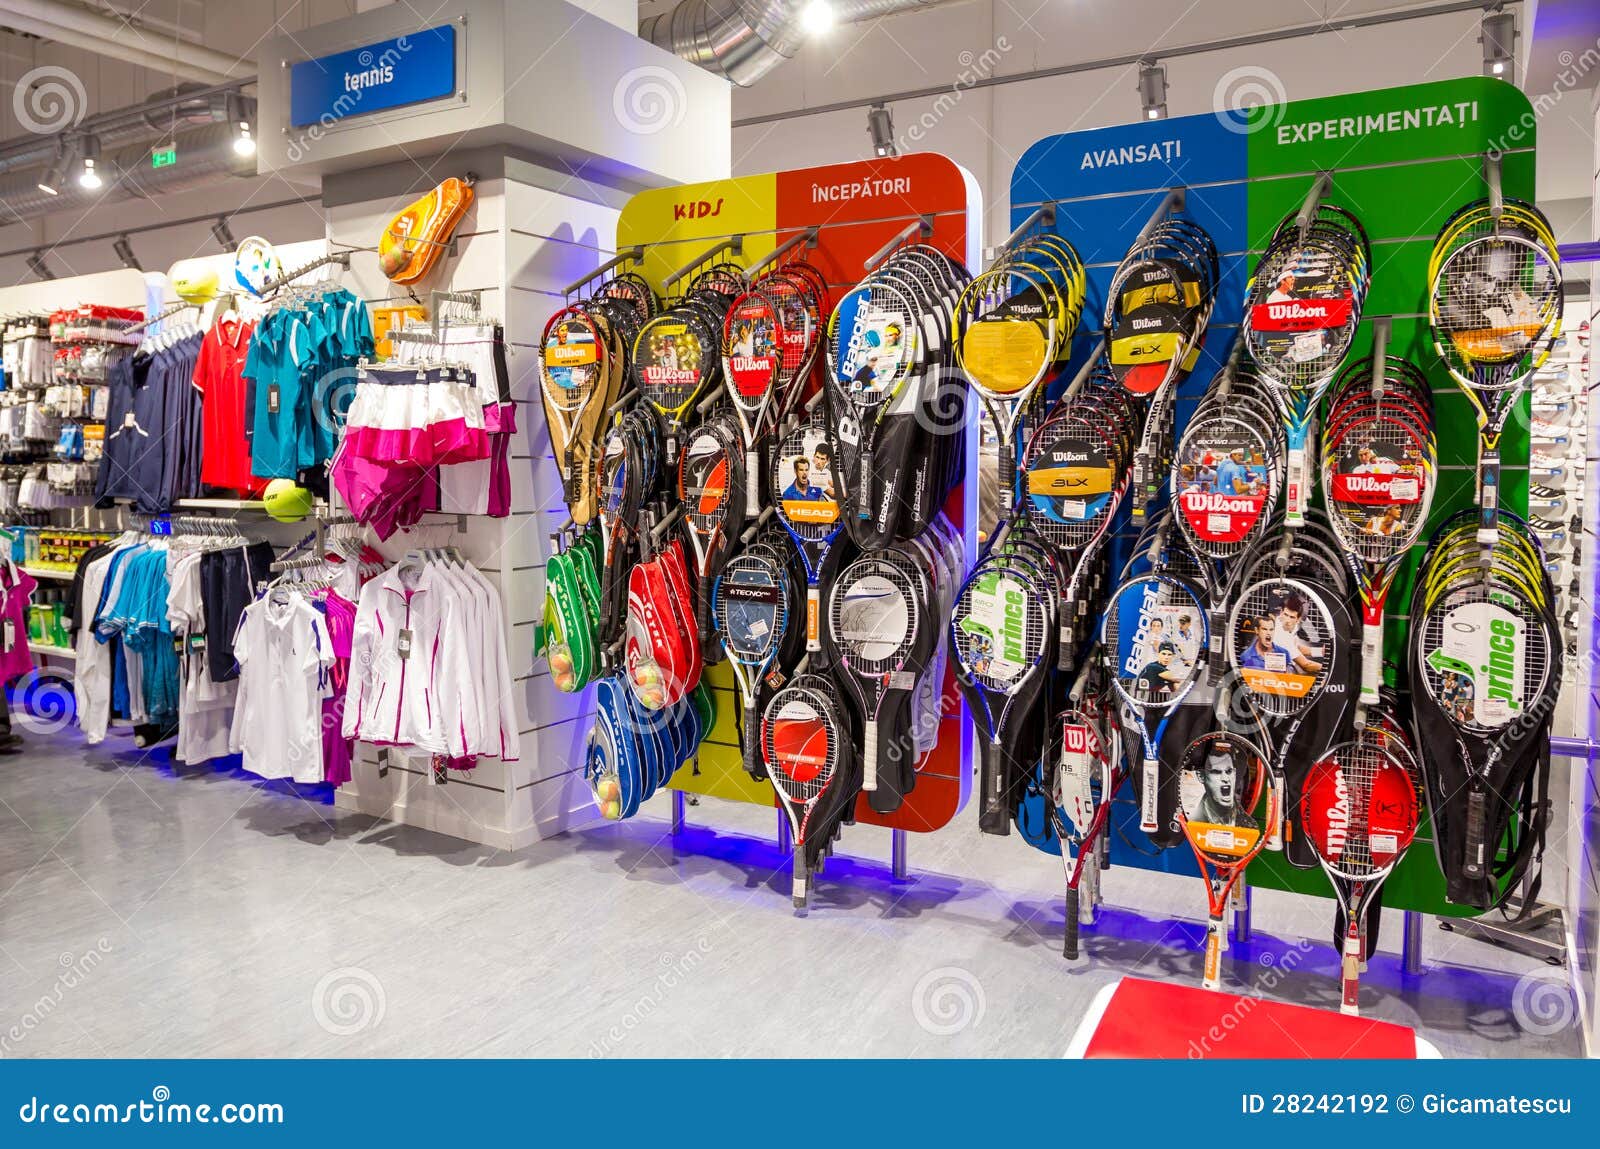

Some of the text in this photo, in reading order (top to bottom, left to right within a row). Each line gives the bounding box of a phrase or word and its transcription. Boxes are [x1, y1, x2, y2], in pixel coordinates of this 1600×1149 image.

[344, 62, 394, 92] tennis
[1277, 101, 1478, 145] EXPERIMENTAȚI
[1080, 140, 1181, 170] AVANSAȚI
[811, 177, 911, 203] ÎNCEPĂTORI
[673, 198, 724, 222] KIDS
[1010, 304, 1043, 314] Wilson
[1268, 304, 1328, 320] Wilson
[1132, 318, 1162, 330] Wilson
[842, 294, 870, 378] Babolat
[554, 347, 586, 359] Wilson
[646, 366, 695, 380] Wilson
[733, 357, 770, 371] Wilson
[1052, 451, 1088, 462] Wilson
[1345, 477, 1393, 492] Wilso
[789, 508, 834, 517] HEAD
[1186, 493, 1257, 513] Wilson
[998, 590, 1026, 665] prince
[1125, 584, 1159, 676] Babolat
[1480, 618, 1519, 710] prince
[1251, 677, 1304, 691] HEAD
[1325, 684, 1345, 693] YOU
[1278, 719, 1302, 768] HEAD
[1327, 770, 1349, 856] Wilson
